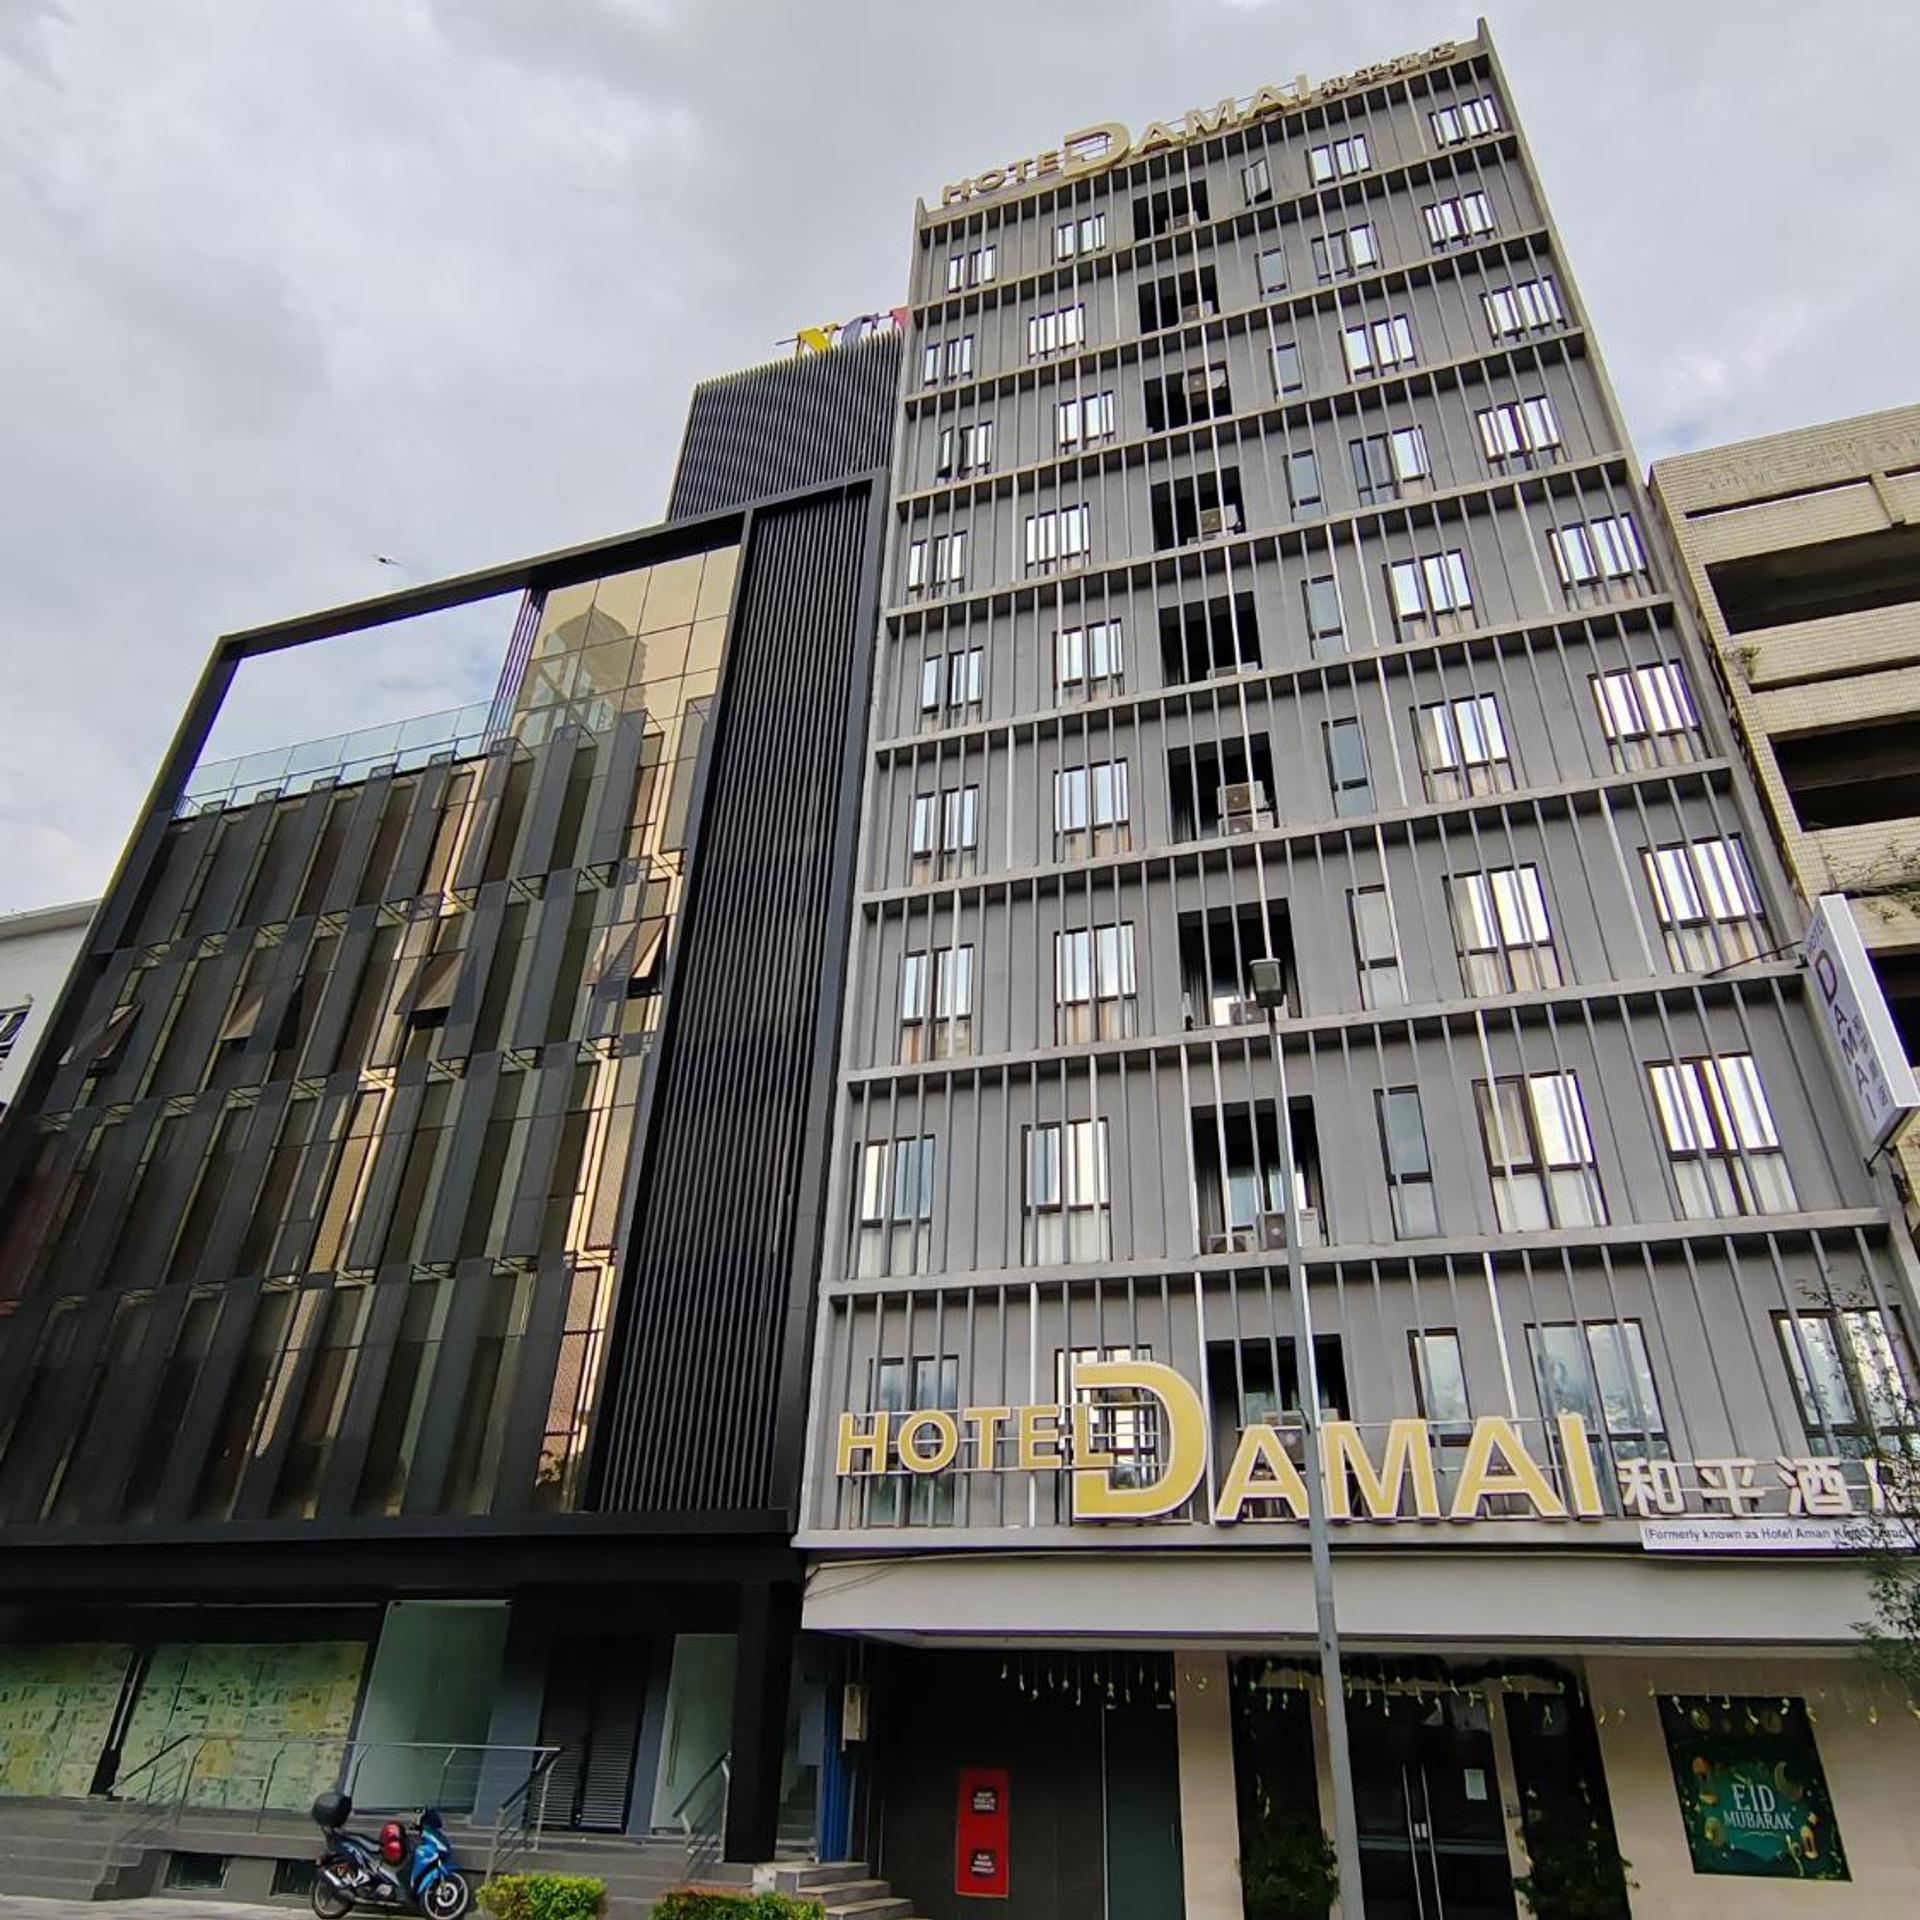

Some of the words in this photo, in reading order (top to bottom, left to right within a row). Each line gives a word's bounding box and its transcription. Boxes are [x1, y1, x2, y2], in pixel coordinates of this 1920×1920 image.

[1064, 73, 1313, 179] DAMAI
[1815, 949, 1877, 1121] DAMAI
[835, 1404, 1115, 1476] HOTEL
[1073, 1361, 1604, 1523] DAMAI
[1703, 1528, 1741, 1539] known
[1744, 1530, 1759, 1539] as
[1761, 1527, 1793, 1540] Hotel
[1796, 1527, 1831, 1539] Aman
[1723, 1809, 1795, 1831] MUBARAK
[1732, 1783, 1776, 1813] EID
